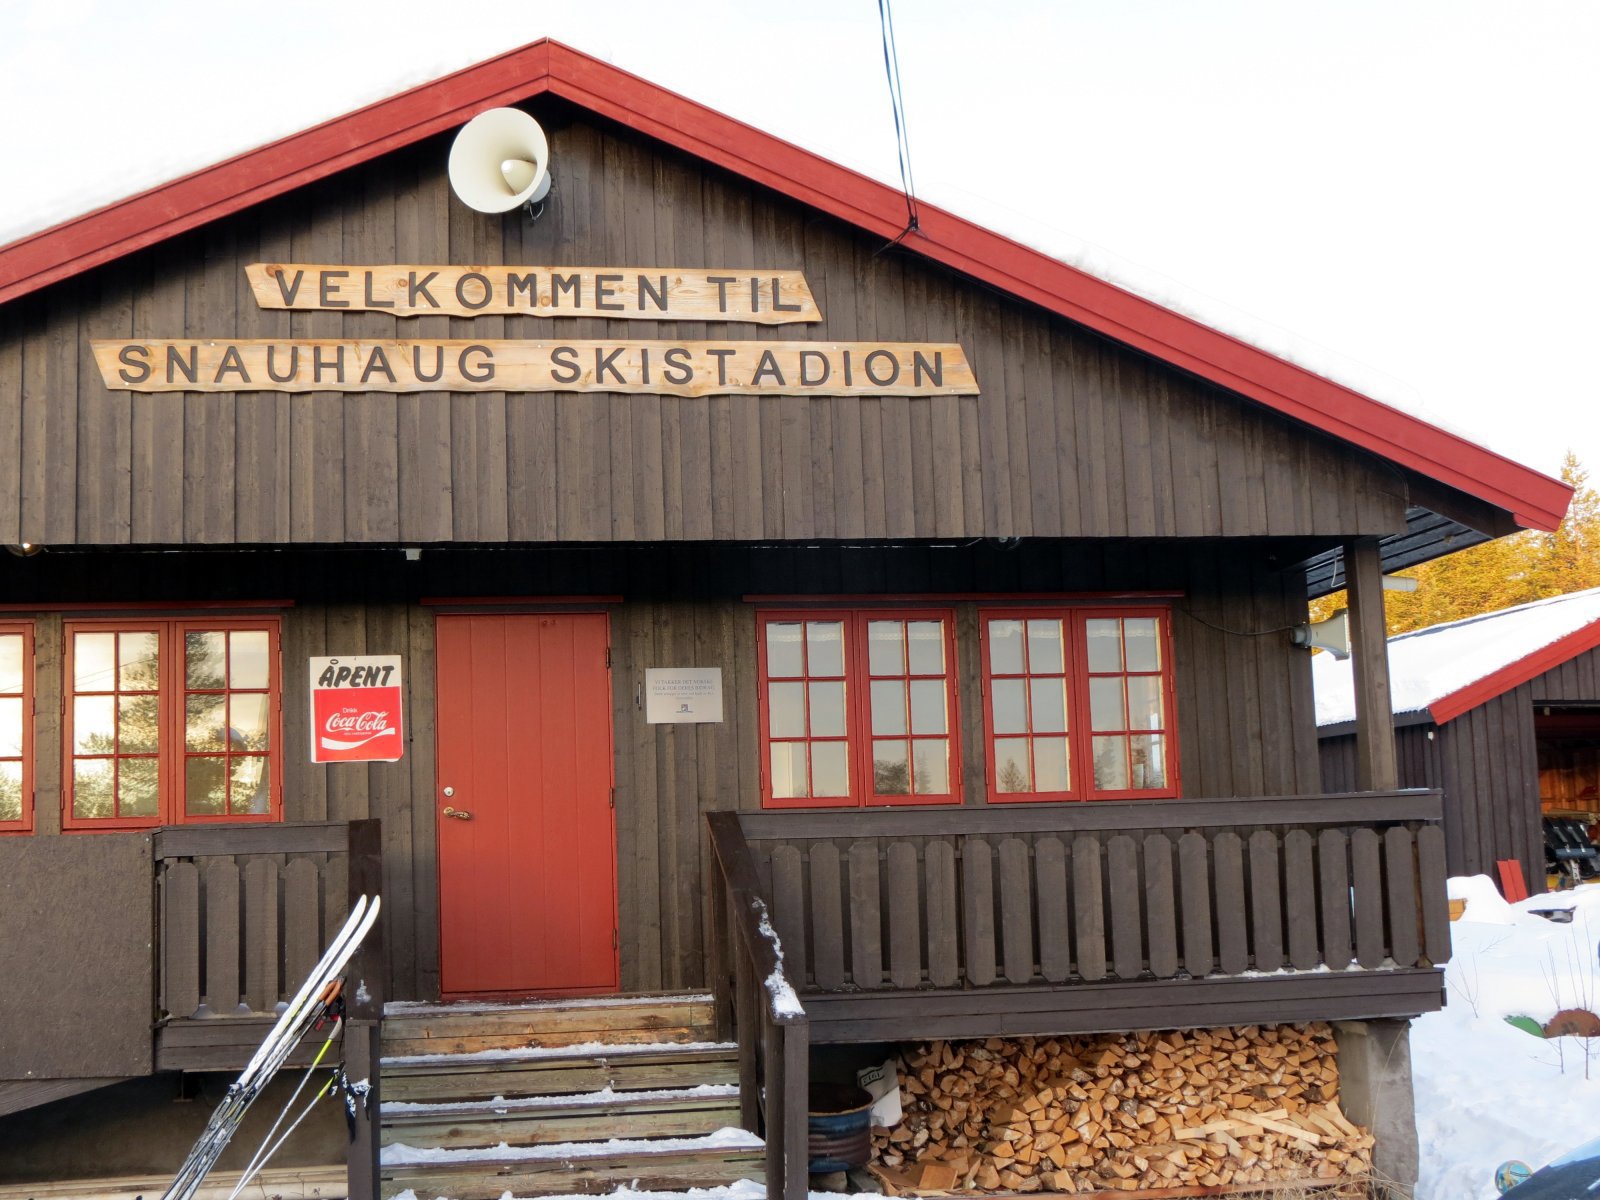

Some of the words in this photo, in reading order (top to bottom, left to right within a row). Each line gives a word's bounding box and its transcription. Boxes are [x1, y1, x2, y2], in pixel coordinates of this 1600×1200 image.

[275, 270, 668, 311] VELKOMMEN
[706, 275, 802, 313] TIL
[117, 344, 497, 385] SNAUHAUG
[549, 346, 944, 388] SKISTADION
[318, 658, 395, 688] ÅPENT
